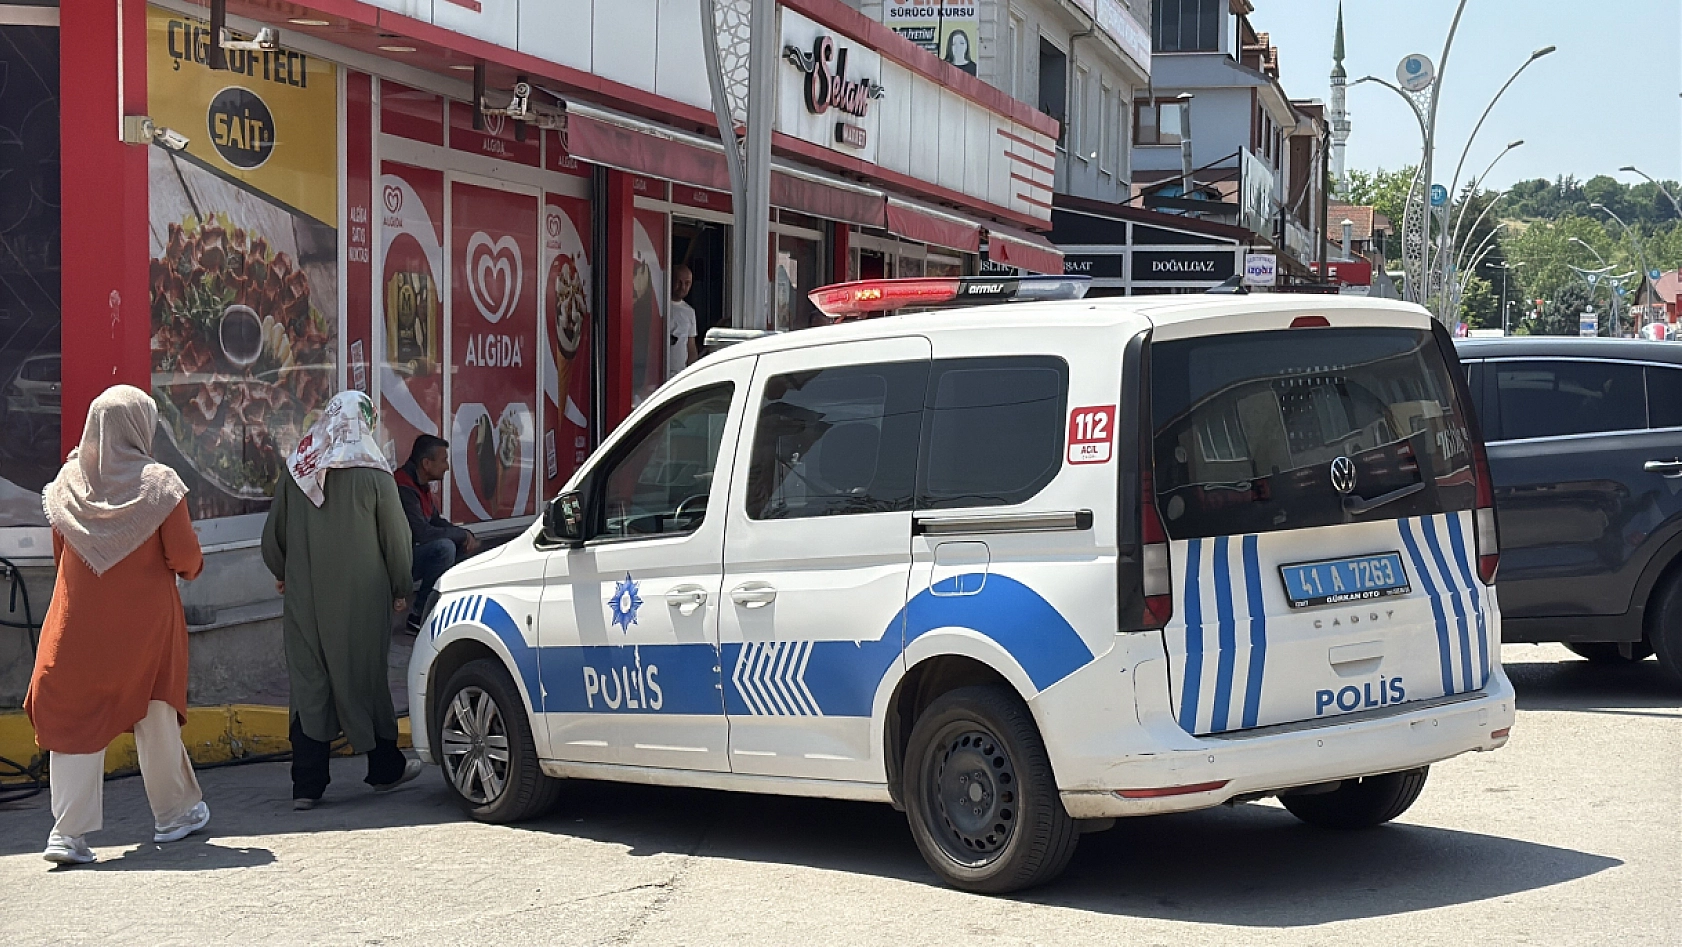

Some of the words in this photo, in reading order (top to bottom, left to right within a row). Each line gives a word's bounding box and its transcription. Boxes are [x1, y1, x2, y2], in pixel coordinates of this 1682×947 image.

[890, 7, 934, 17] SÜRÜCÜ
[938, 8, 975, 17] KURSU
[214, 109, 263, 152] SAİT
[1152, 259, 1215, 272] DOĞALGAZ
[1075, 411, 1109, 440] 112
[1300, 565, 1323, 595] 41
[1330, 565, 1345, 591] A
[1348, 558, 1396, 588] 7263
[1362, 590, 1380, 599] OTO
[1313, 609, 1394, 629] CADDY
[1315, 674, 1405, 715] POLİS
